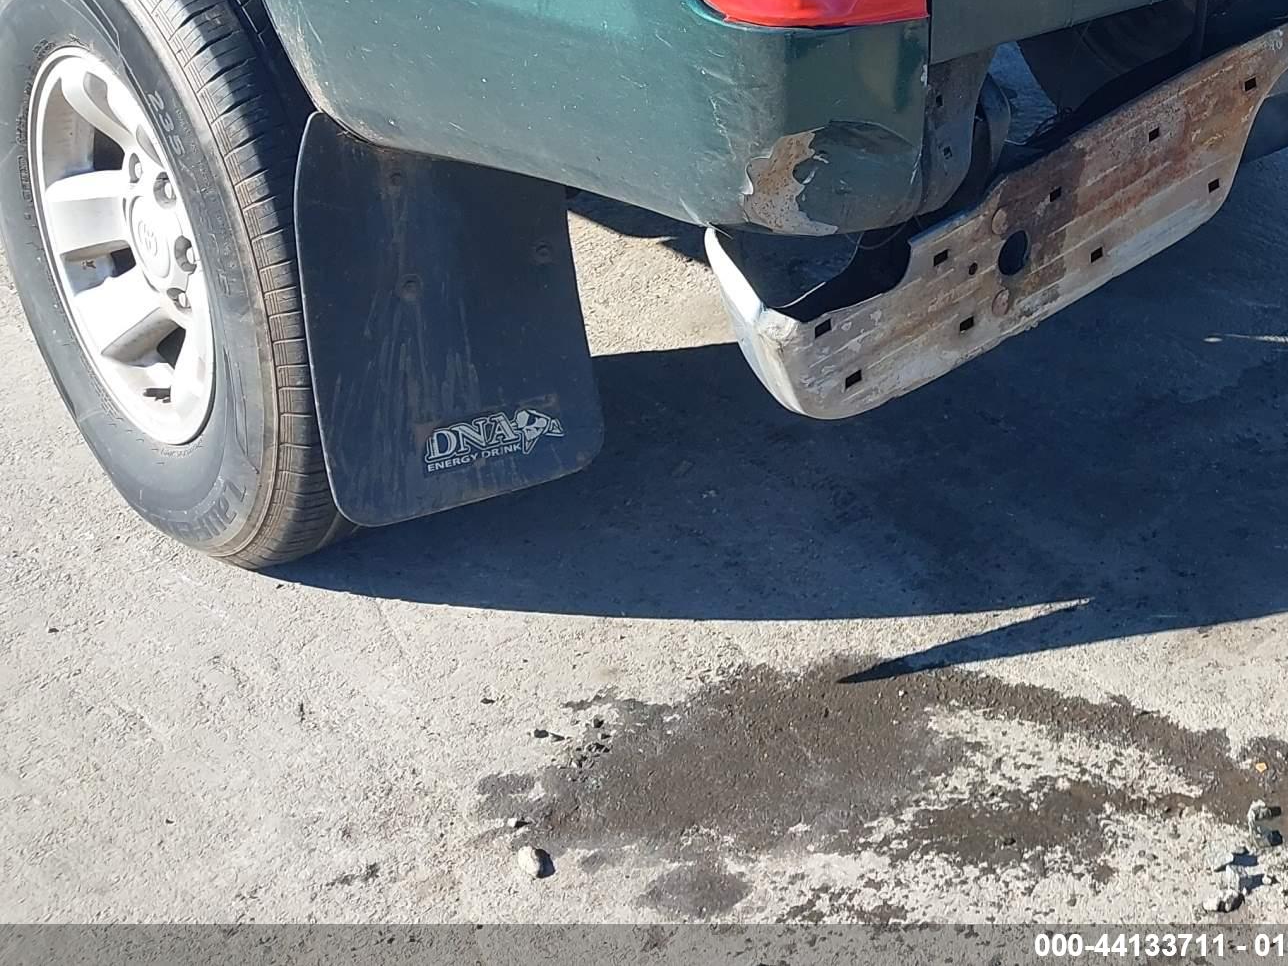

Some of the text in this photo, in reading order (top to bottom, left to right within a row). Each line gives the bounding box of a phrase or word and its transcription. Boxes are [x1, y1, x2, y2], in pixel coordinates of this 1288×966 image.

[149, 90, 185, 156] 235
[426, 413, 521, 462] DNA
[428, 443, 522, 471] ENERGY DRINK
